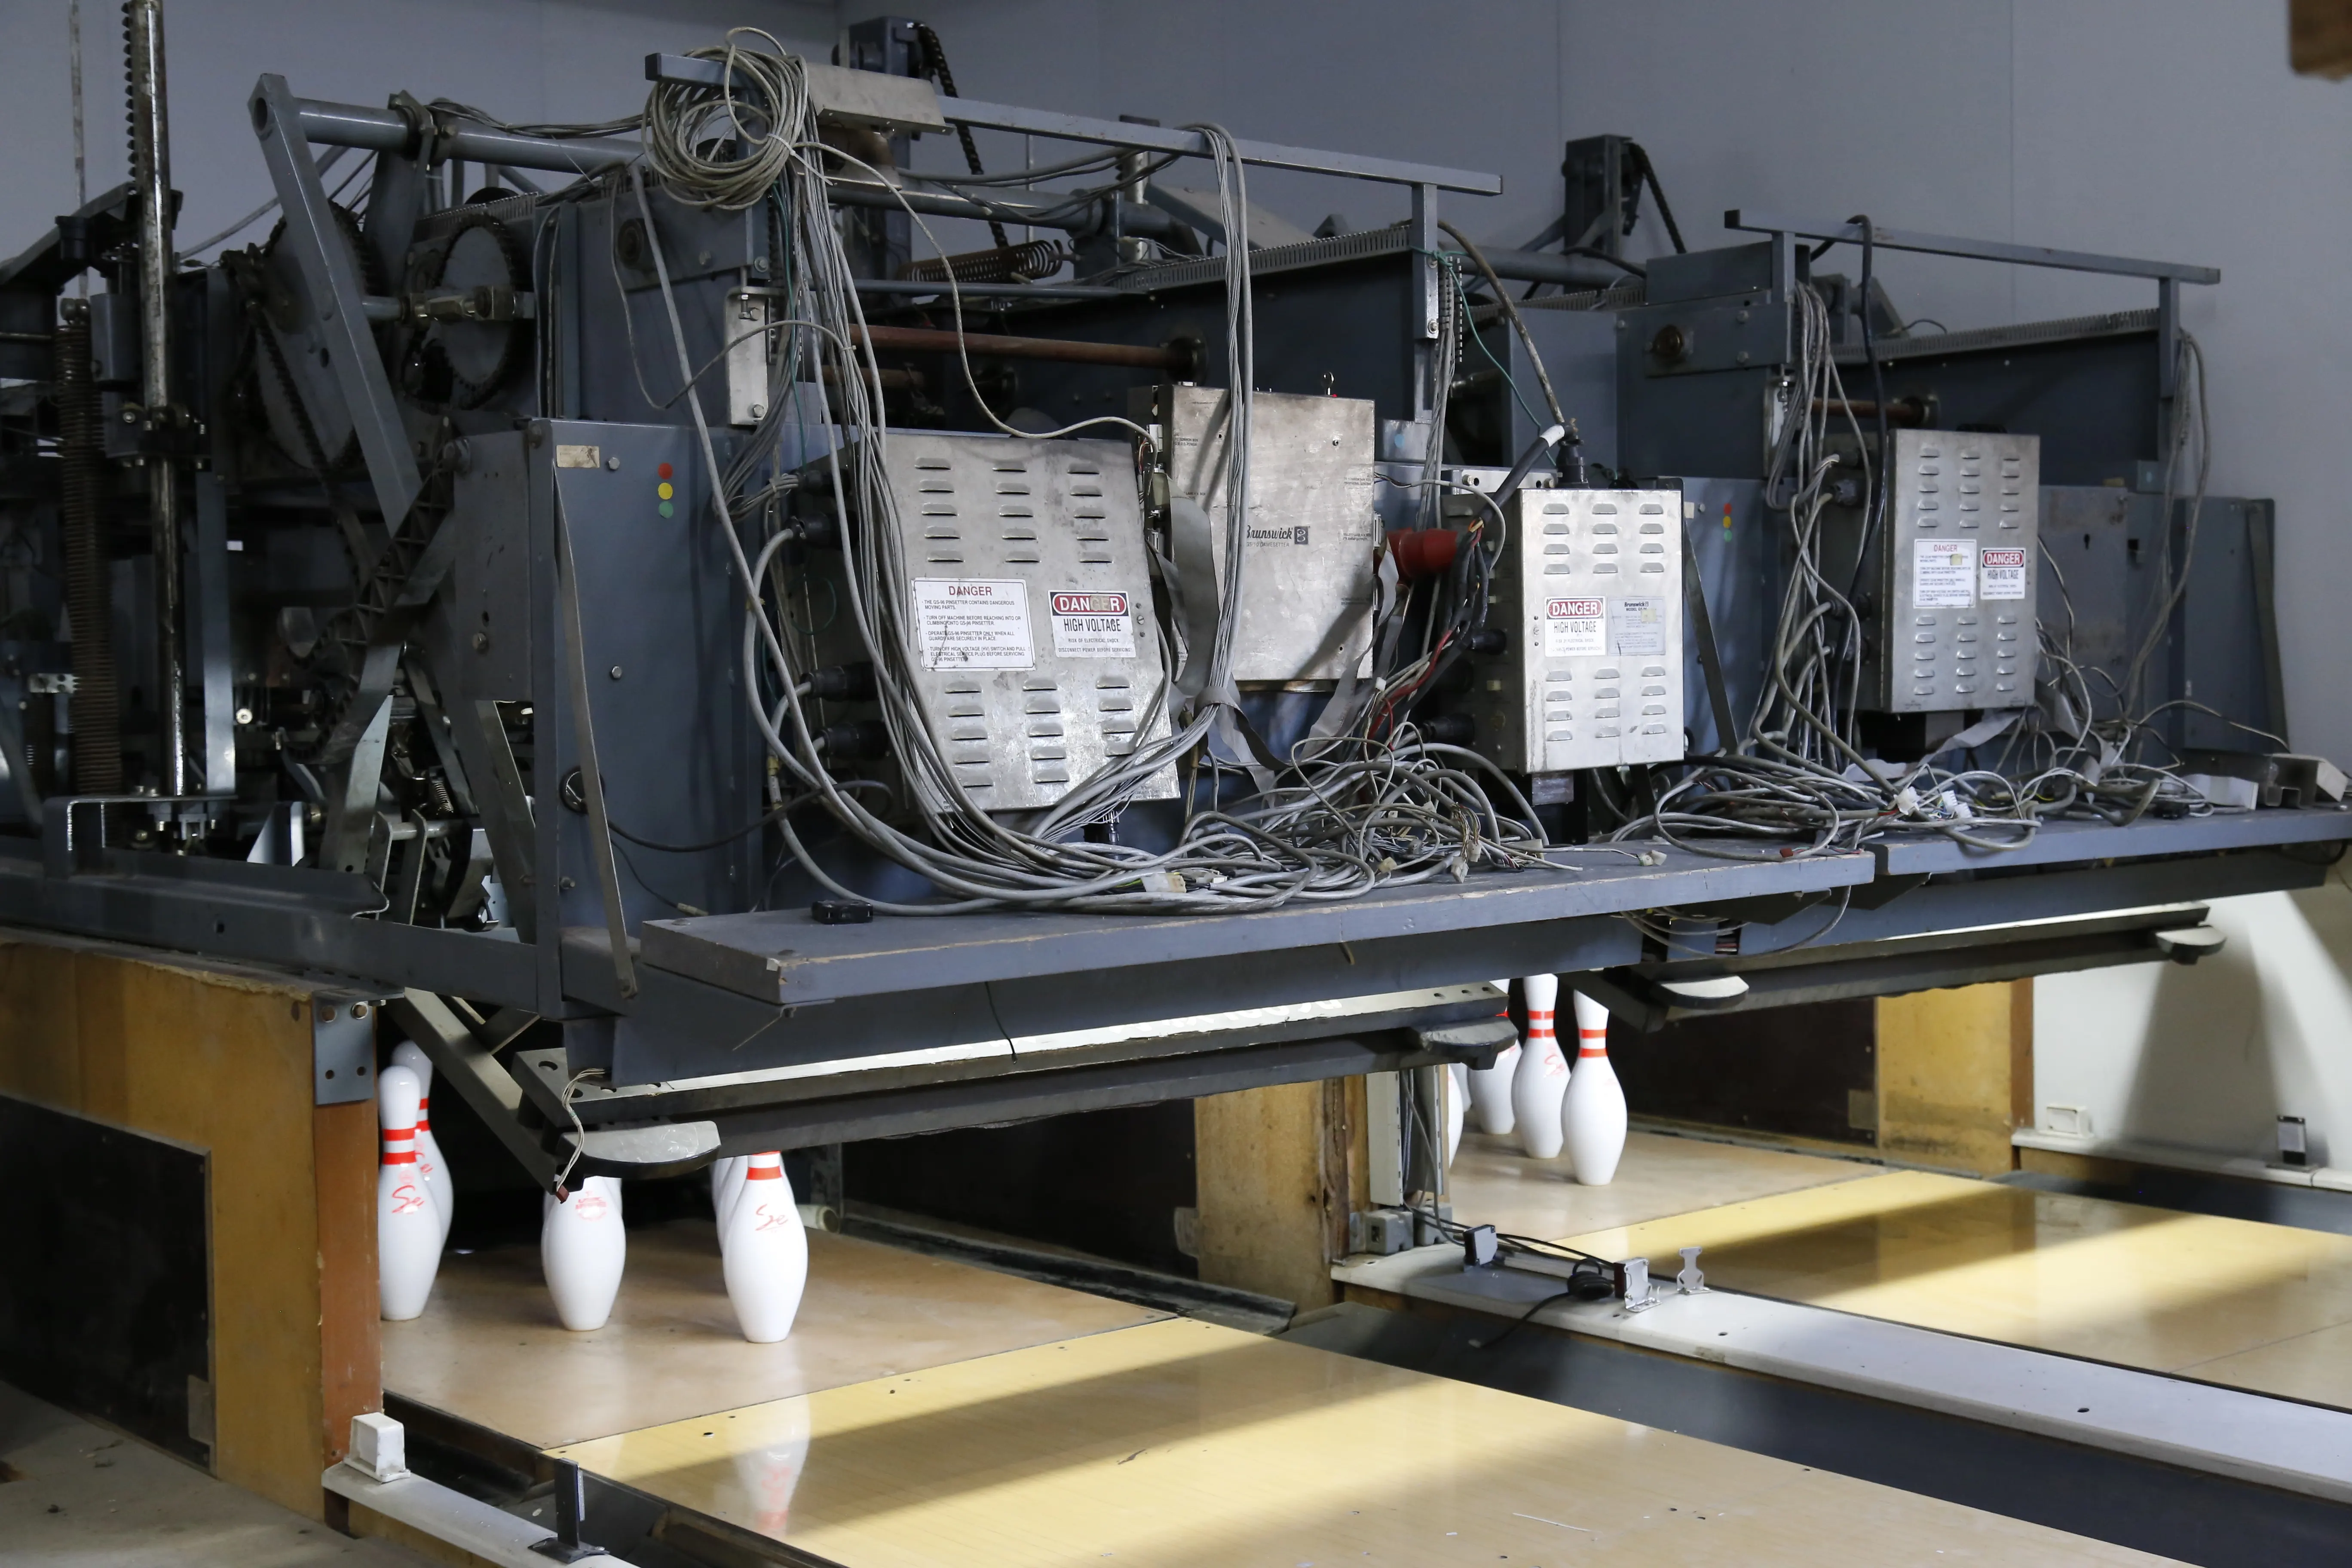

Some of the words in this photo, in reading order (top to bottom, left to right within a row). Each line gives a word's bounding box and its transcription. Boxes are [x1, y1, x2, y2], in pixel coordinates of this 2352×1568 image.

[1987, 553, 2020, 564] DANGER
[948, 586, 992, 596] DANGER
[1060, 597, 1120, 611] DANGER
[1552, 602, 1598, 615] DANGER
[1064, 619, 1084, 631] HIGH
[1085, 619, 1121, 631] VOLTAGE
[1554, 621, 1568, 633] HIGH
[1570, 621, 1596, 633] VOLTAGE
